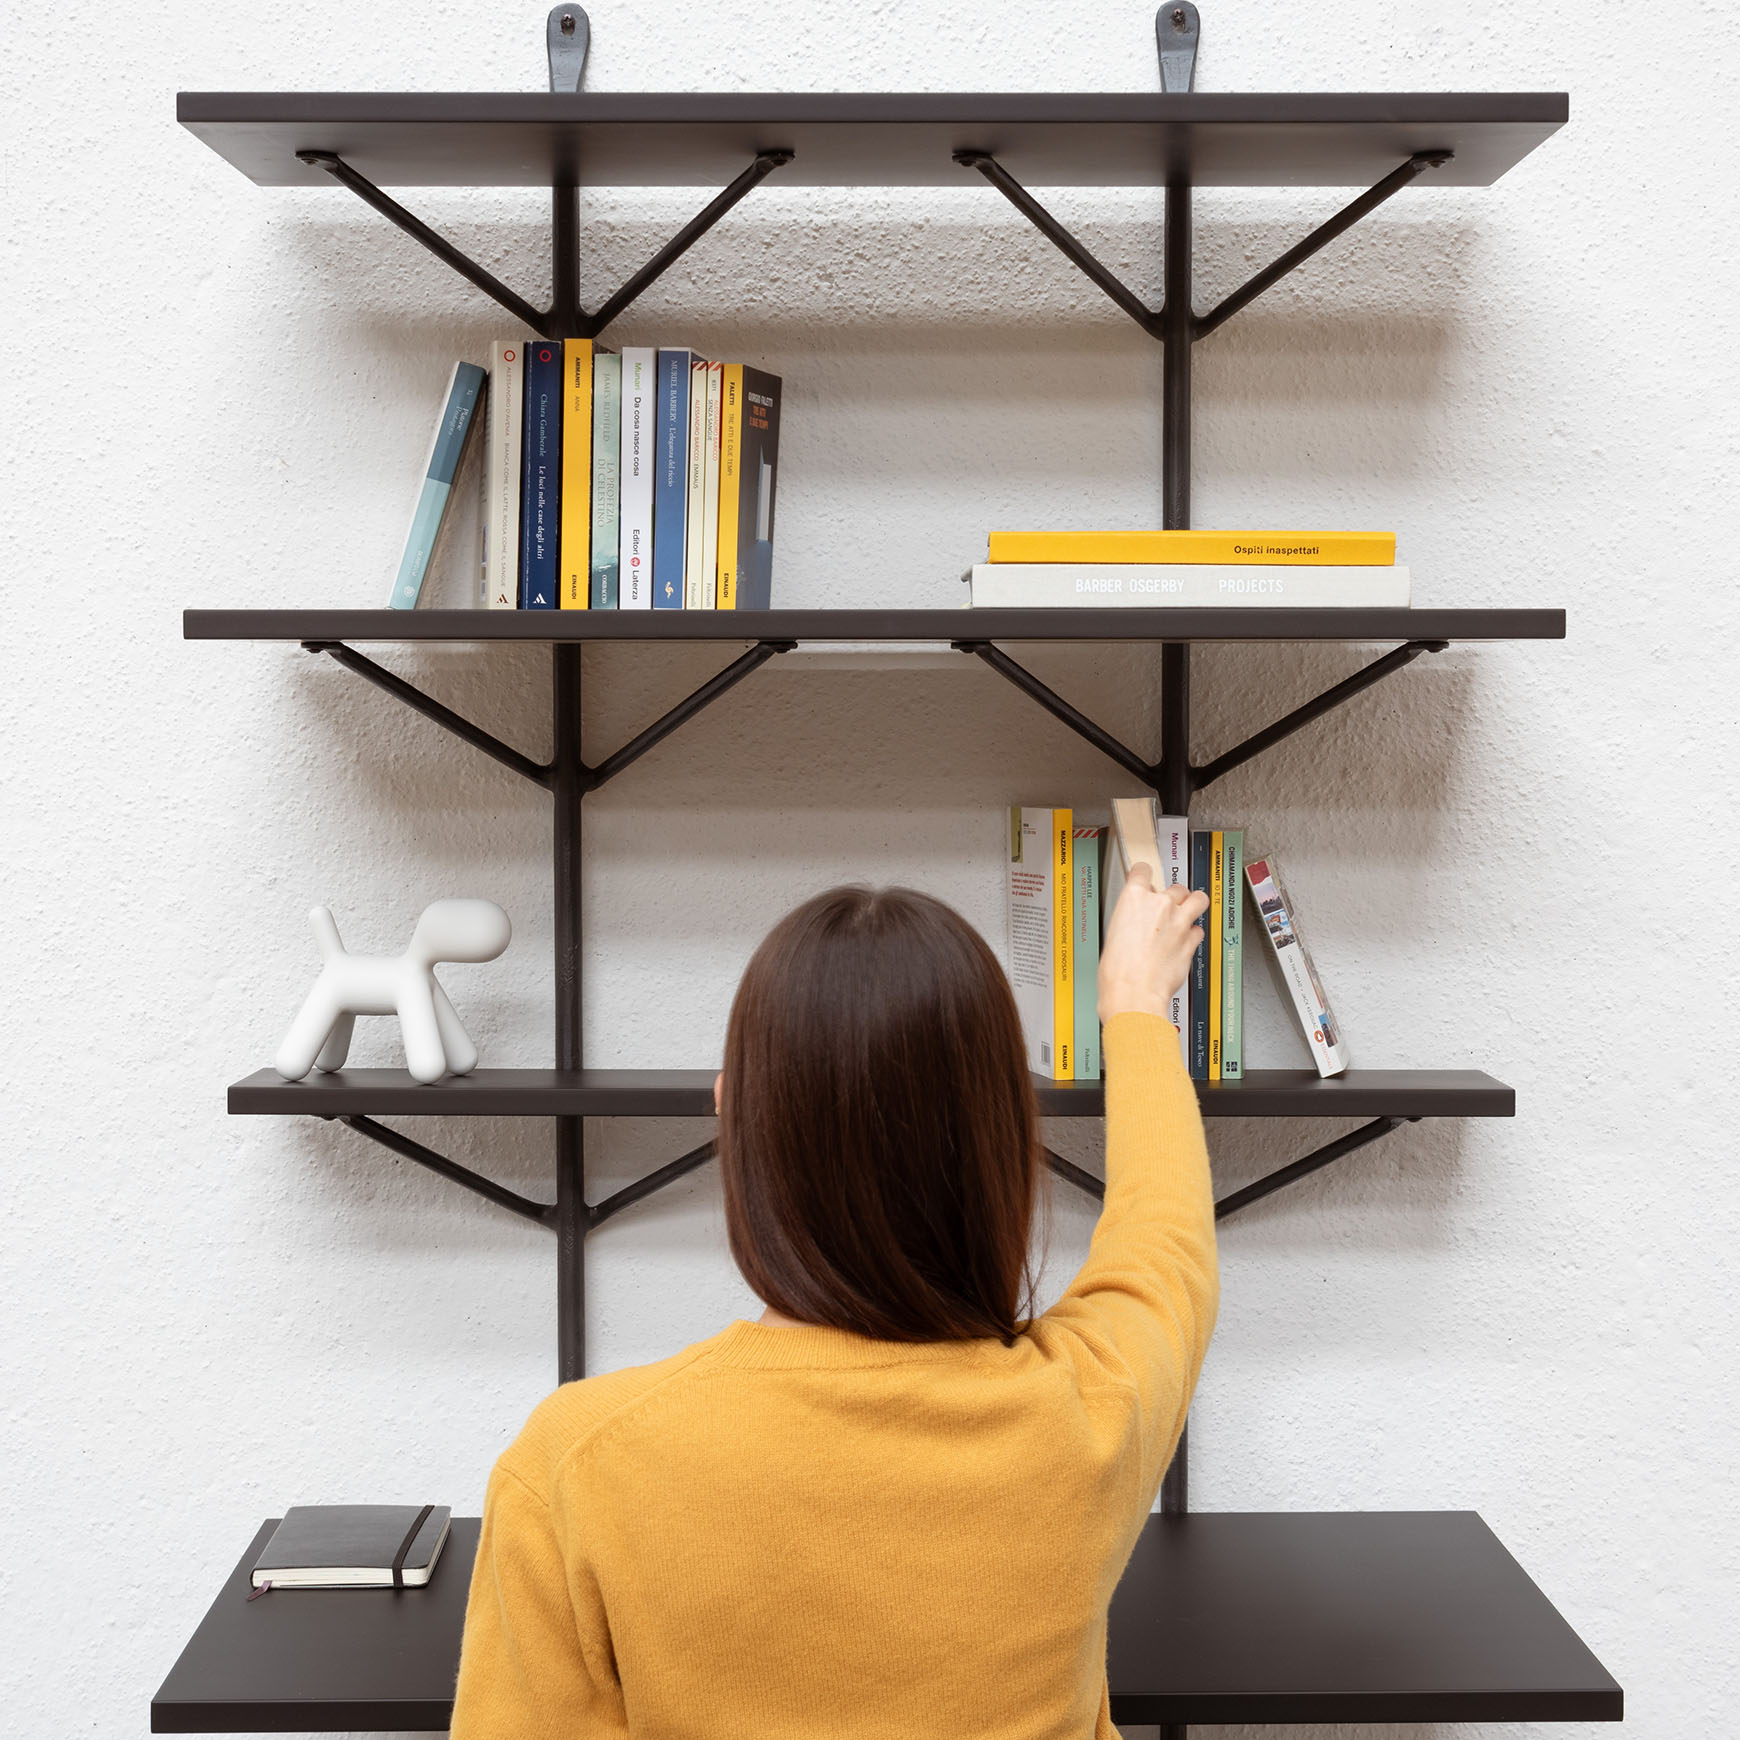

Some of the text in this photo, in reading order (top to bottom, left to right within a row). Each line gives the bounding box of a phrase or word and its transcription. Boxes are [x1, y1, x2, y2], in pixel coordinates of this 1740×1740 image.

[634, 362, 642, 391] Munari
[670, 360, 678, 388] MURIEL
[602, 373, 611, 442] JAMES REDFIELD
[634, 397, 641, 408] Da
[669, 390, 677, 422] BARBERY
[539, 393, 548, 457] Chiara Gamberale
[668, 428, 676, 458] L'eleganza
[538, 466, 546, 474] Le
[538, 476, 546, 490] luci
[597, 459, 606, 528] DI CELESTINO
[606, 463, 615, 524] LA PROFEZIA
[535, 525, 545, 543] degli
[1234, 545, 1319, 556] Ospiti inaspettati
[632, 529, 641, 600] Editori Laterza
[1075, 578, 1185, 593] BARBER OSGERBY
[1219, 578, 1284, 593] PROJECTS
[1228, 846, 1236, 929] CHIMAMANDA NGOZI ADICHIE
[1227, 950, 1235, 961] THE
[1227, 963, 1235, 981] THING
[1288, 954, 1293, 965] ON
[1294, 974, 1303, 988] ROAD
[1227, 983, 1235, 1008] AROUND
[1301, 993, 1309, 1006] JACK
[1197, 1021, 1204, 1029] La
